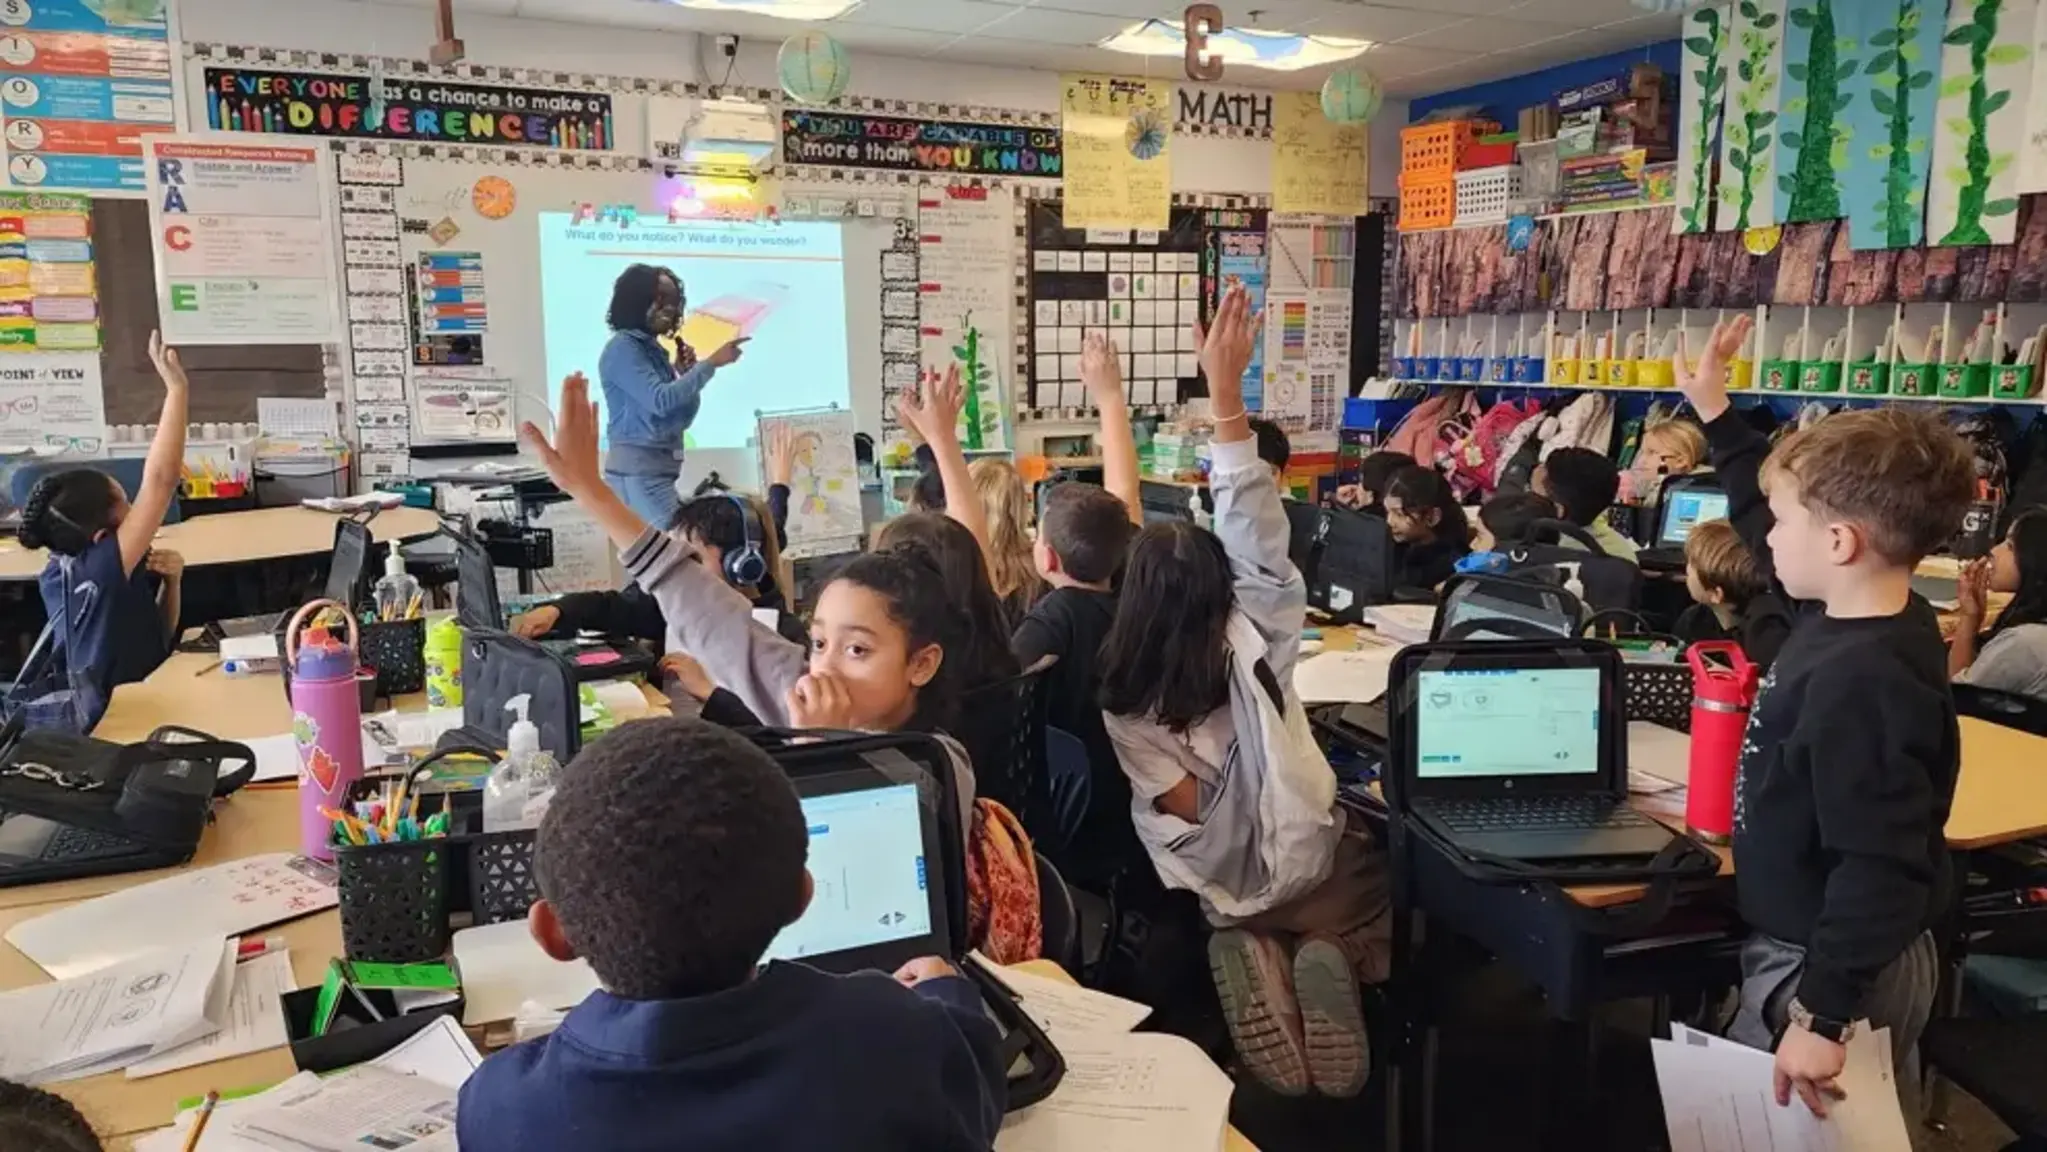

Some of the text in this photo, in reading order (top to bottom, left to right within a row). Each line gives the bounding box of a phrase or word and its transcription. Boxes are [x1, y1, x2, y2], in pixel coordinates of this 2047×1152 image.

[12, 80, 27, 93] O
[220, 74, 601, 112] EVERYONE as a chance to make a
[1178, 87, 1273, 127] MATH
[18, 122, 32, 135] R
[808, 118, 861, 138] YOU
[864, 120, 917, 140] ARE
[1031, 131, 1057, 148] OF
[21, 157, 33, 169] Y
[803, 141, 1061, 173] more than YOU KNOW
[158, 158, 185, 184] R
[163, 185, 188, 212] A
[165, 225, 193, 250] C
[565, 229, 596, 240] What
[600, 231, 614, 241] do
[617, 232, 639, 243] you
[642, 231, 685, 242] notice?
[688, 232, 717, 243] What
[171, 285, 199, 311] E
[52, 368, 84, 380] VIEW
